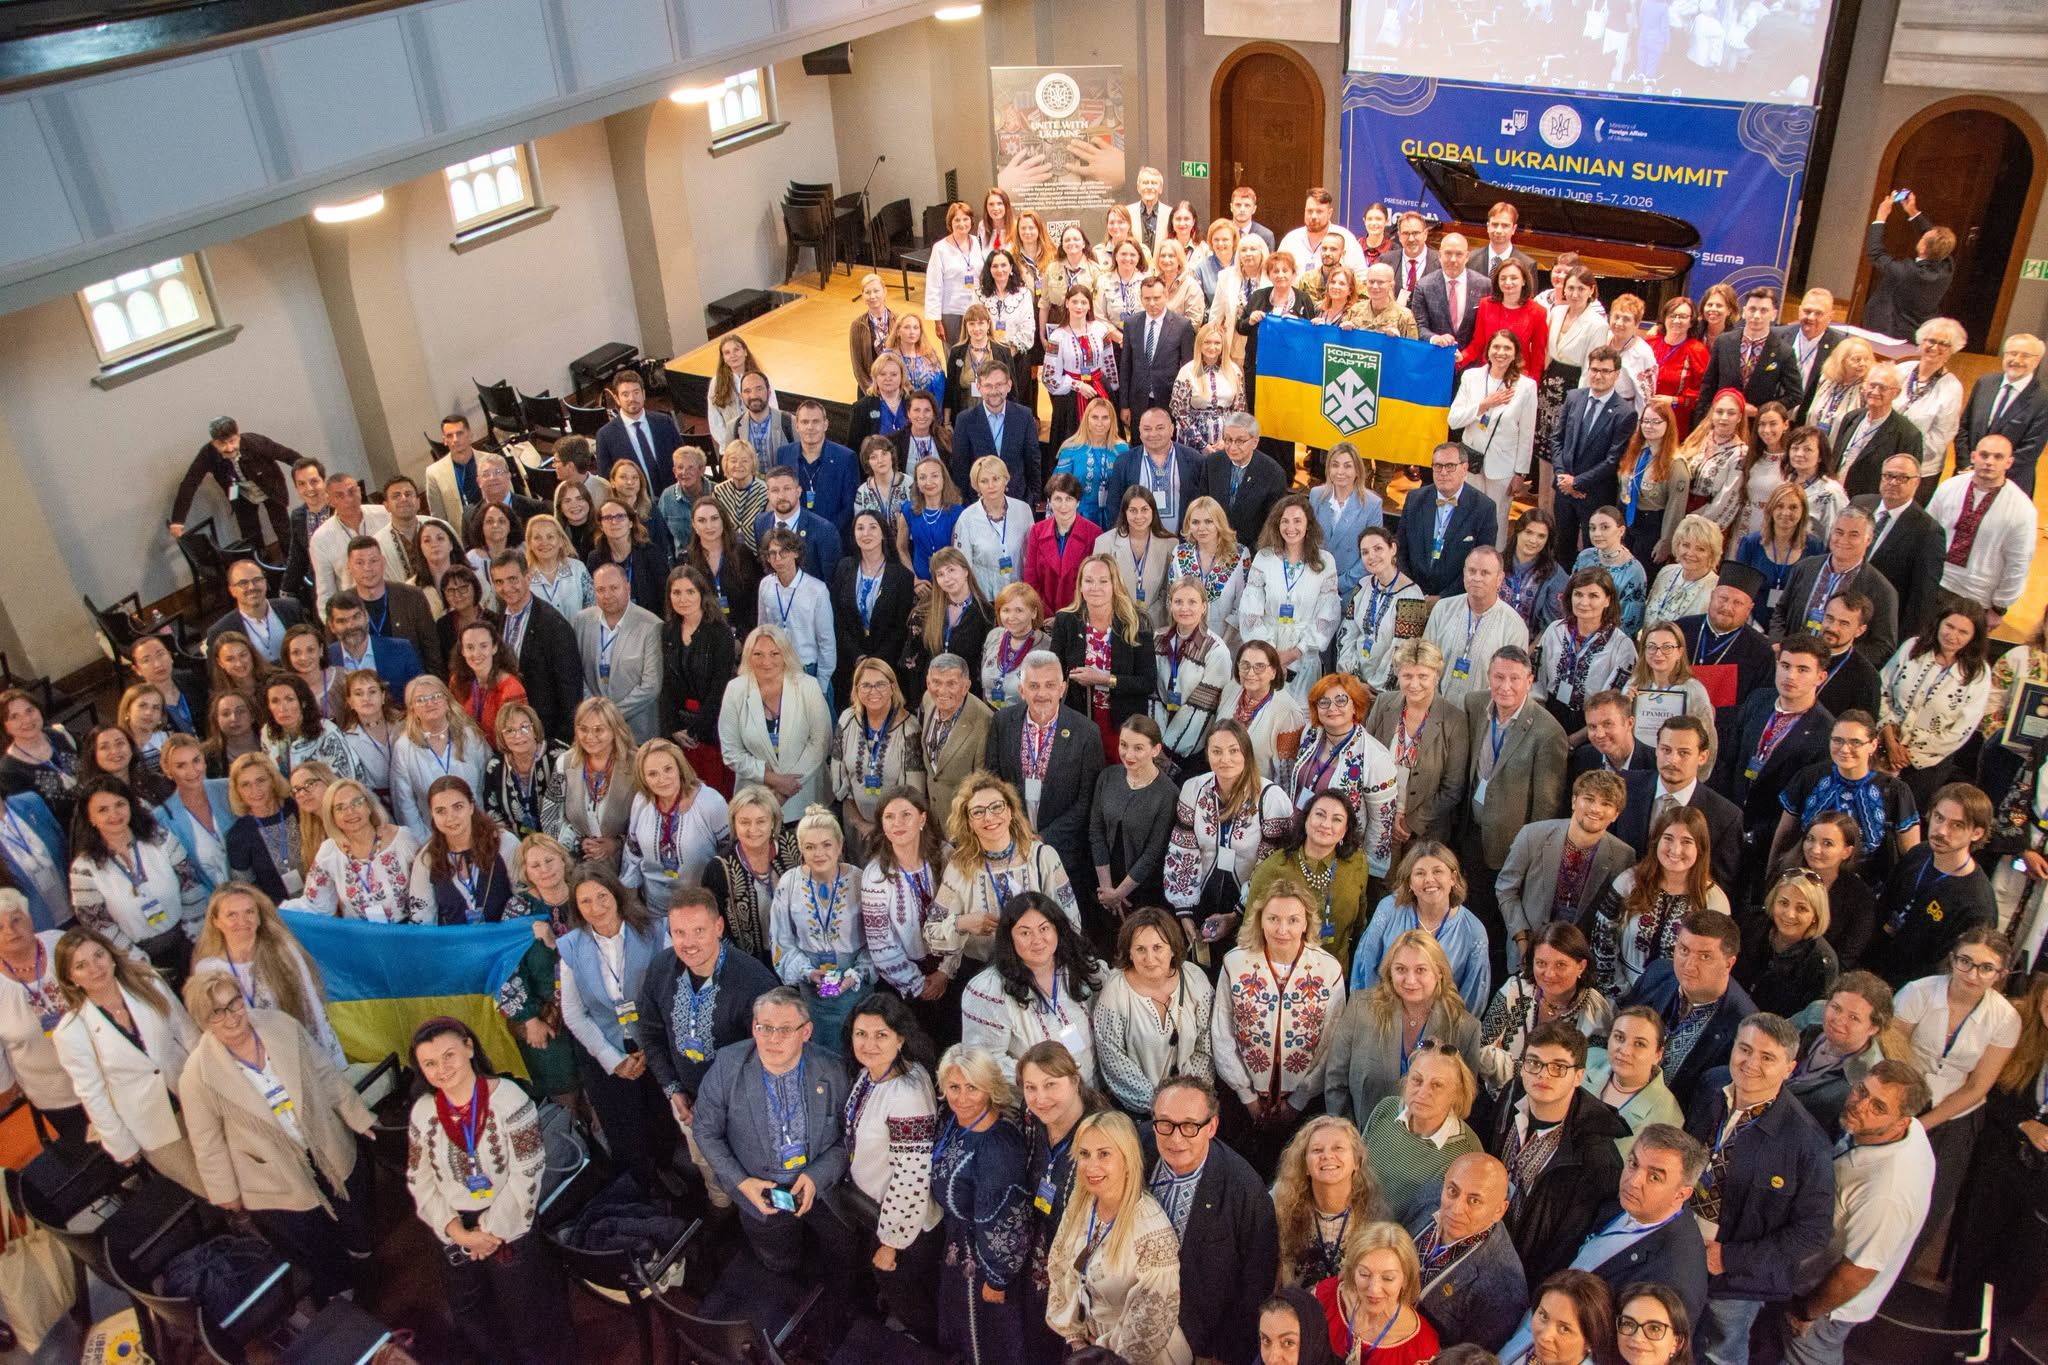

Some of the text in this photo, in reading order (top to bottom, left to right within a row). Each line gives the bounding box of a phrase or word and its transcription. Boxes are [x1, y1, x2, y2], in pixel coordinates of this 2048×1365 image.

[1031, 120, 1088, 130] UNITE WITH
[1039, 129, 1080, 138] UKRAINE
[1401, 139, 1729, 188] GLOBAL UKRAINIAN SUMMIT
[1564, 188, 1593, 201] June
[1623, 195, 1654, 208] 2026
[1327, 347, 1378, 362] КОРПУС
[1327, 355, 1377, 370] ХАРТІЯ
